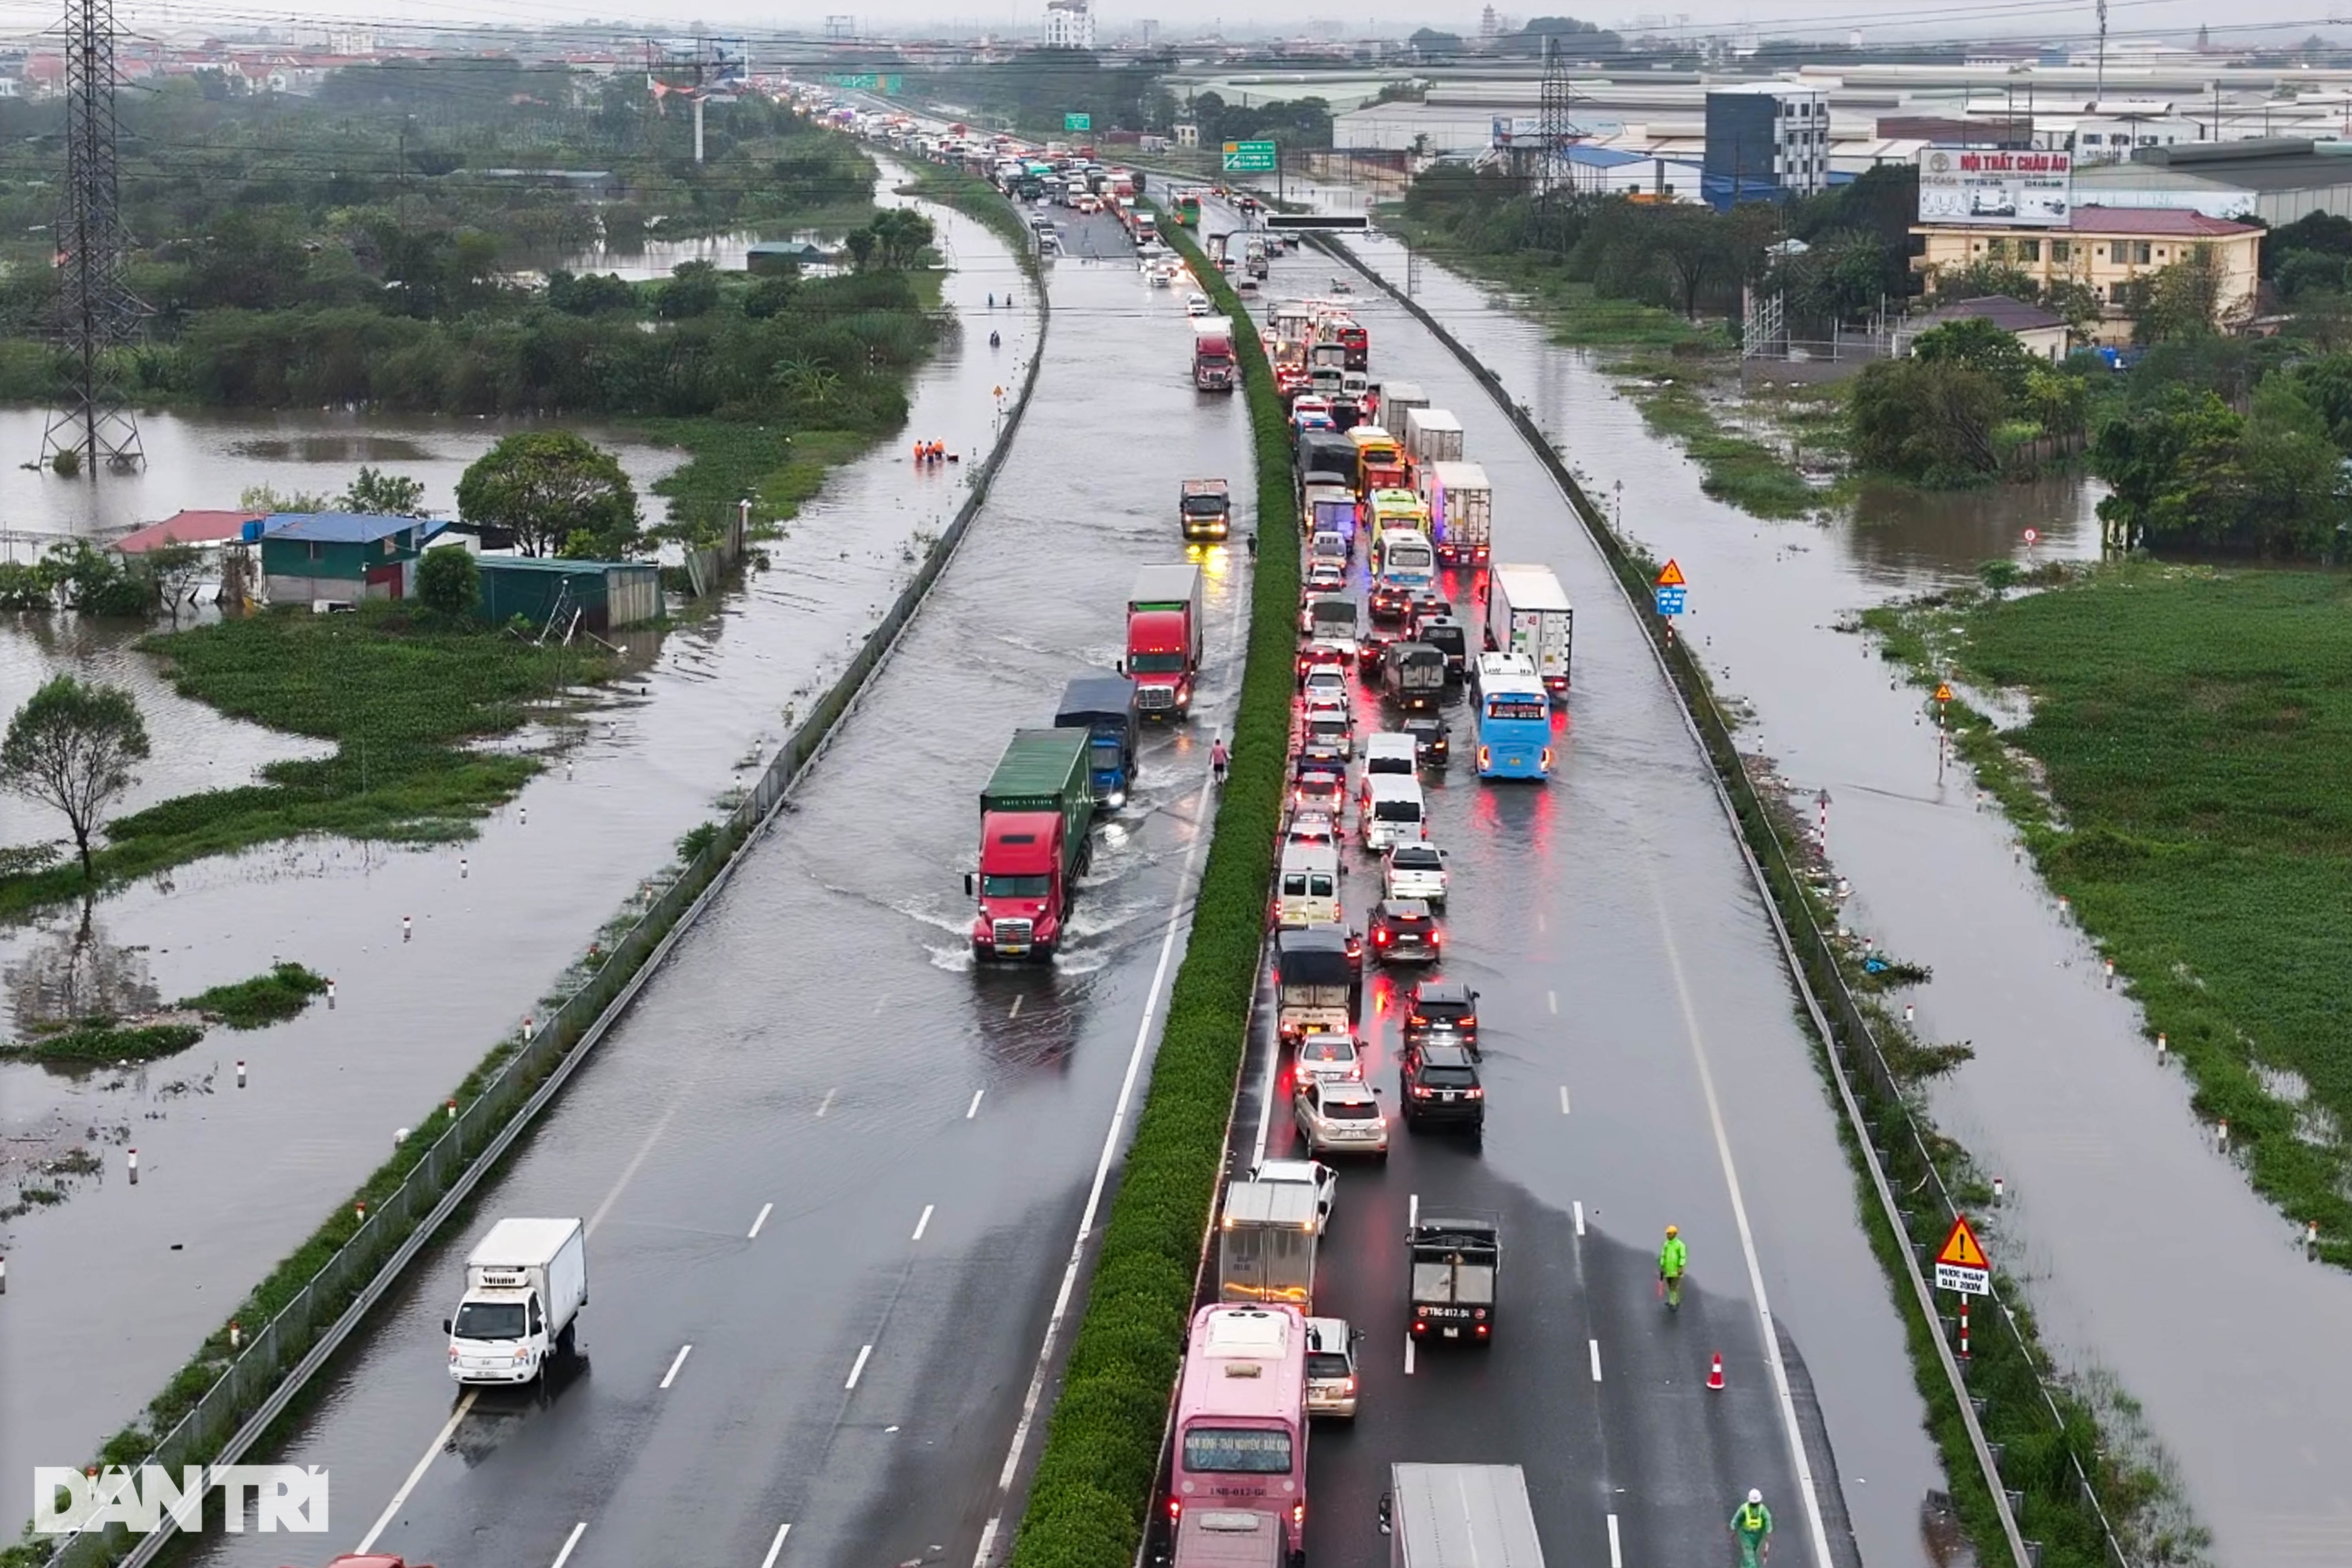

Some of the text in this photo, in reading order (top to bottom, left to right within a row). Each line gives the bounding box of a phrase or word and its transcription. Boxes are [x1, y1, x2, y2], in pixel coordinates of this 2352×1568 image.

[1961, 152, 2067, 172] NỘI THẤT CHÂU ÂU
